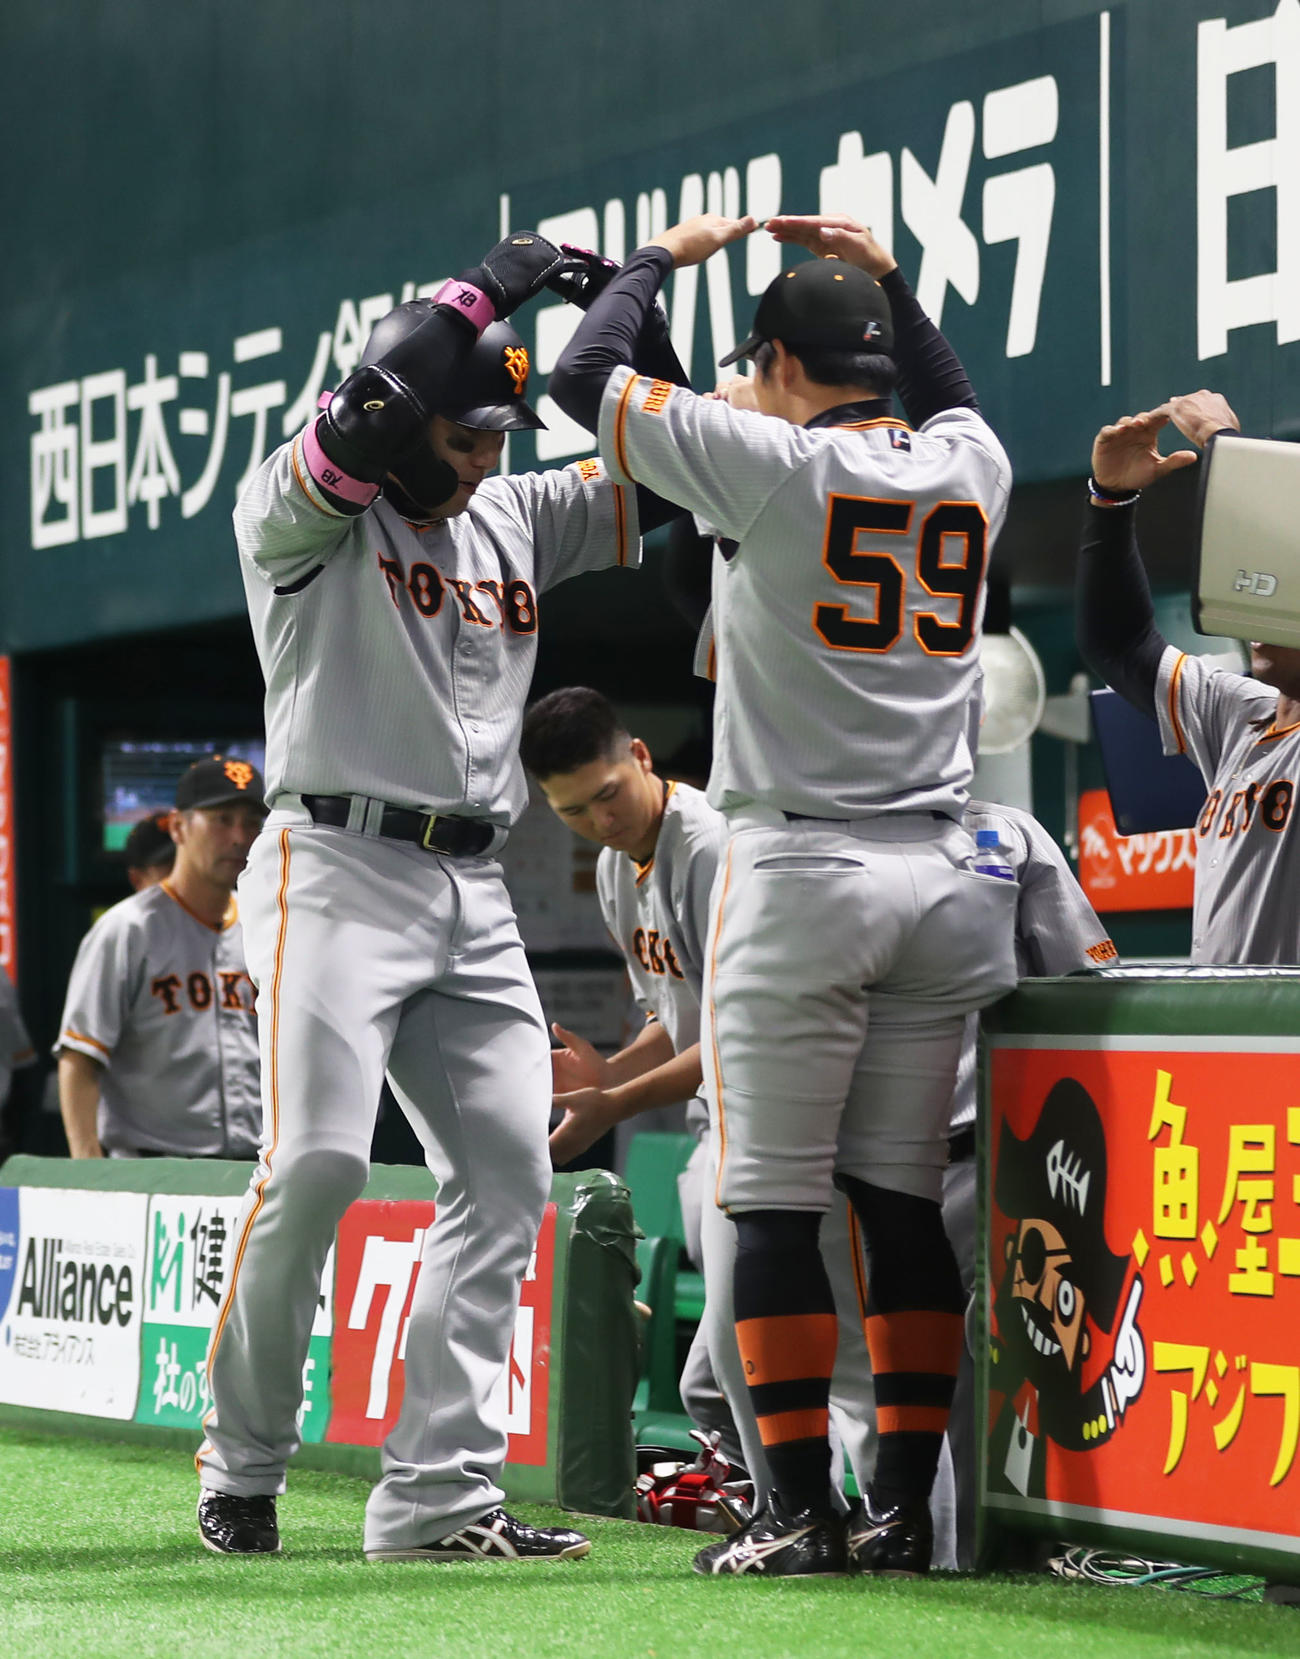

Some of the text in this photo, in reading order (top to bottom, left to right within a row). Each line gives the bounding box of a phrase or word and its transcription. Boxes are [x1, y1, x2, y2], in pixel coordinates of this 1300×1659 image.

[376, 551, 539, 635] TOKYO
[812, 492, 990, 657] 59
[16, 1236, 134, 1328] Alliance
